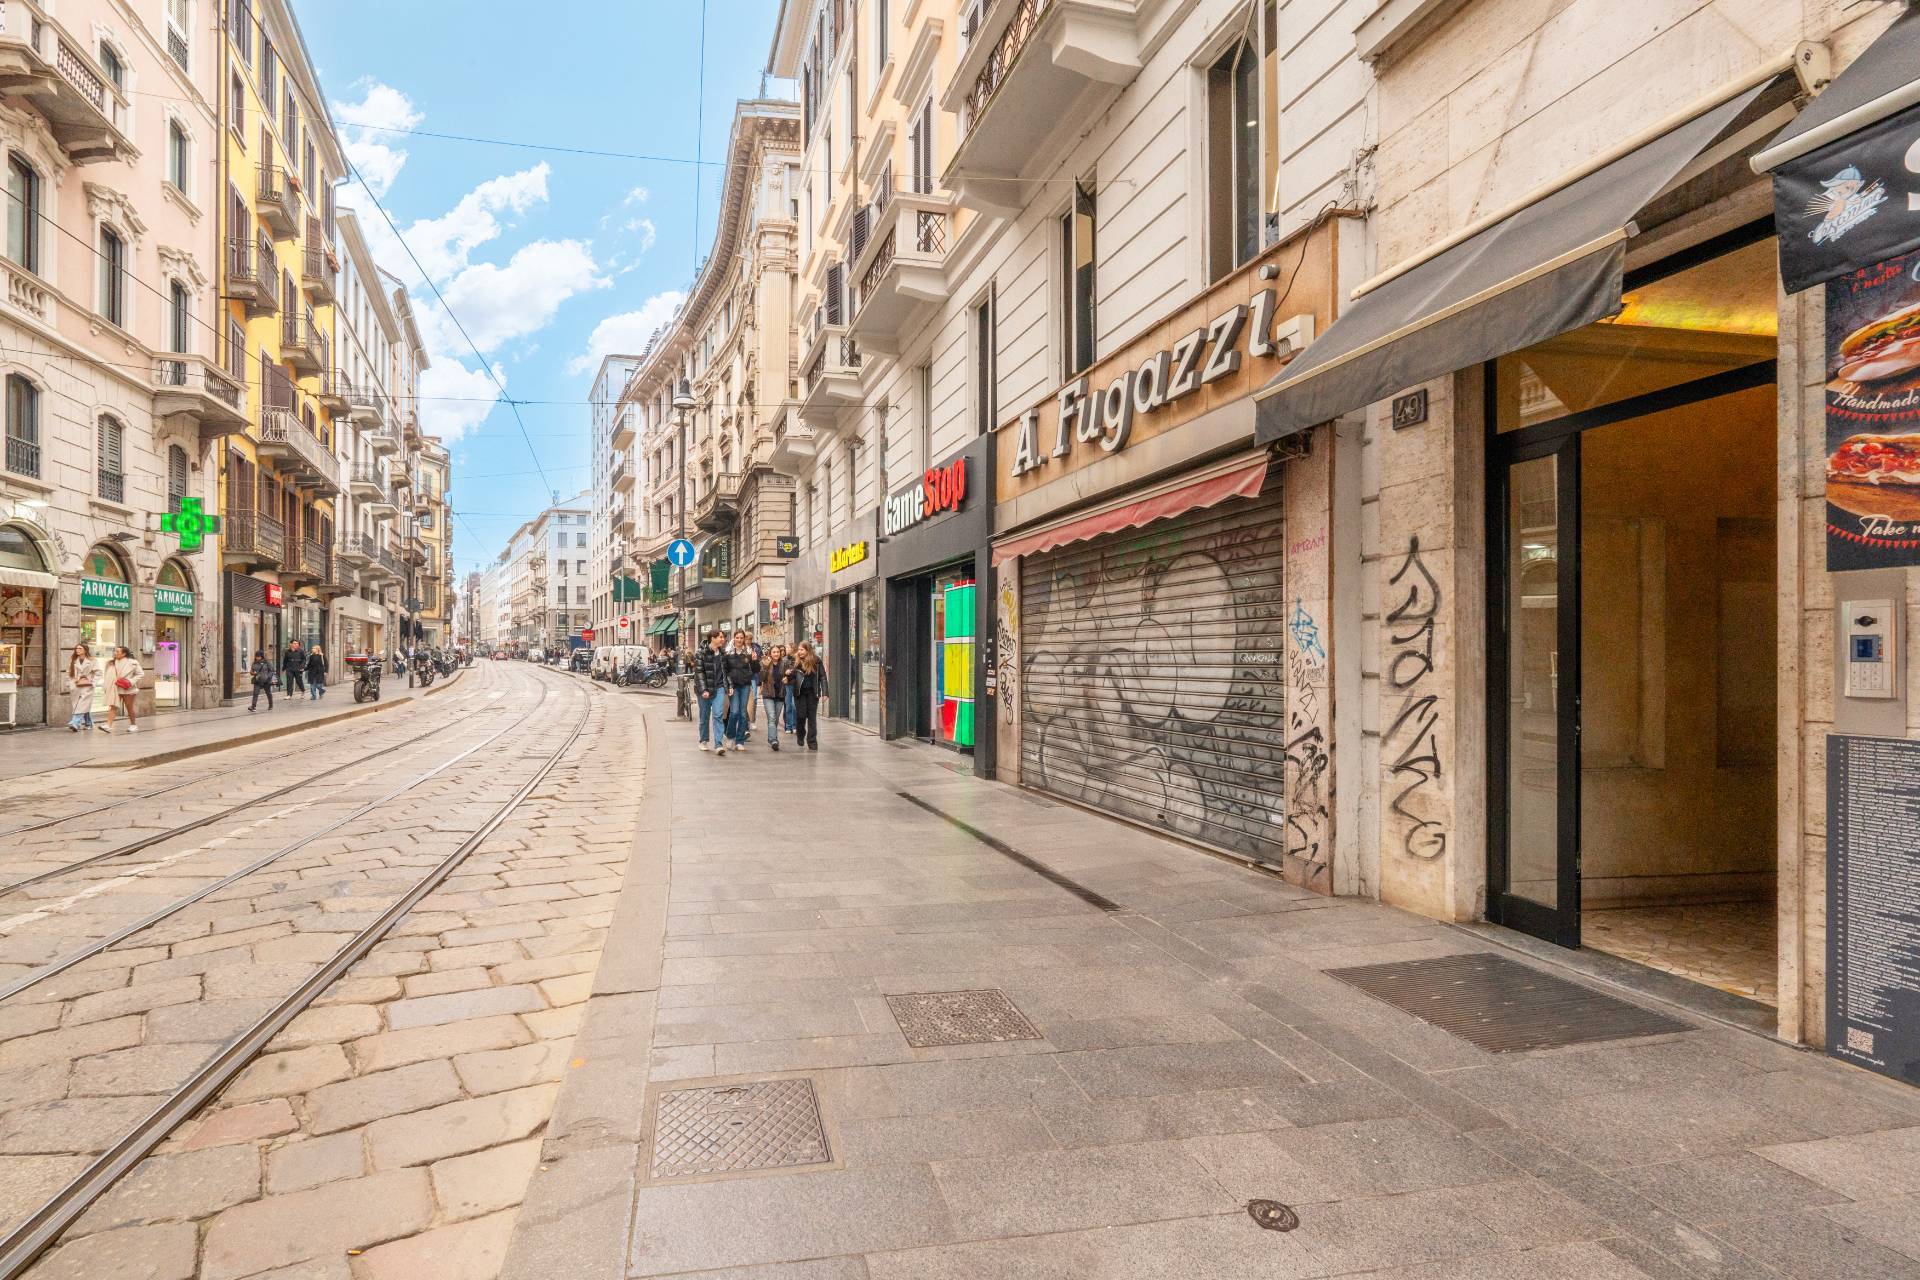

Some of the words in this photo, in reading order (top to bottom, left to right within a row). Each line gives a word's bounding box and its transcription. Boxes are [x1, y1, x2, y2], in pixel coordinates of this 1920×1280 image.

[1011, 407, 1049, 478] A.
[1052, 263, 1280, 457] Fugazzi
[1395, 395, 1419, 423] 49
[1832, 382, 1920, 411] Handmade
[884, 456, 966, 536] GameStop
[1859, 514, 1908, 539] Take
[80, 581, 129, 600] FARMACIA
